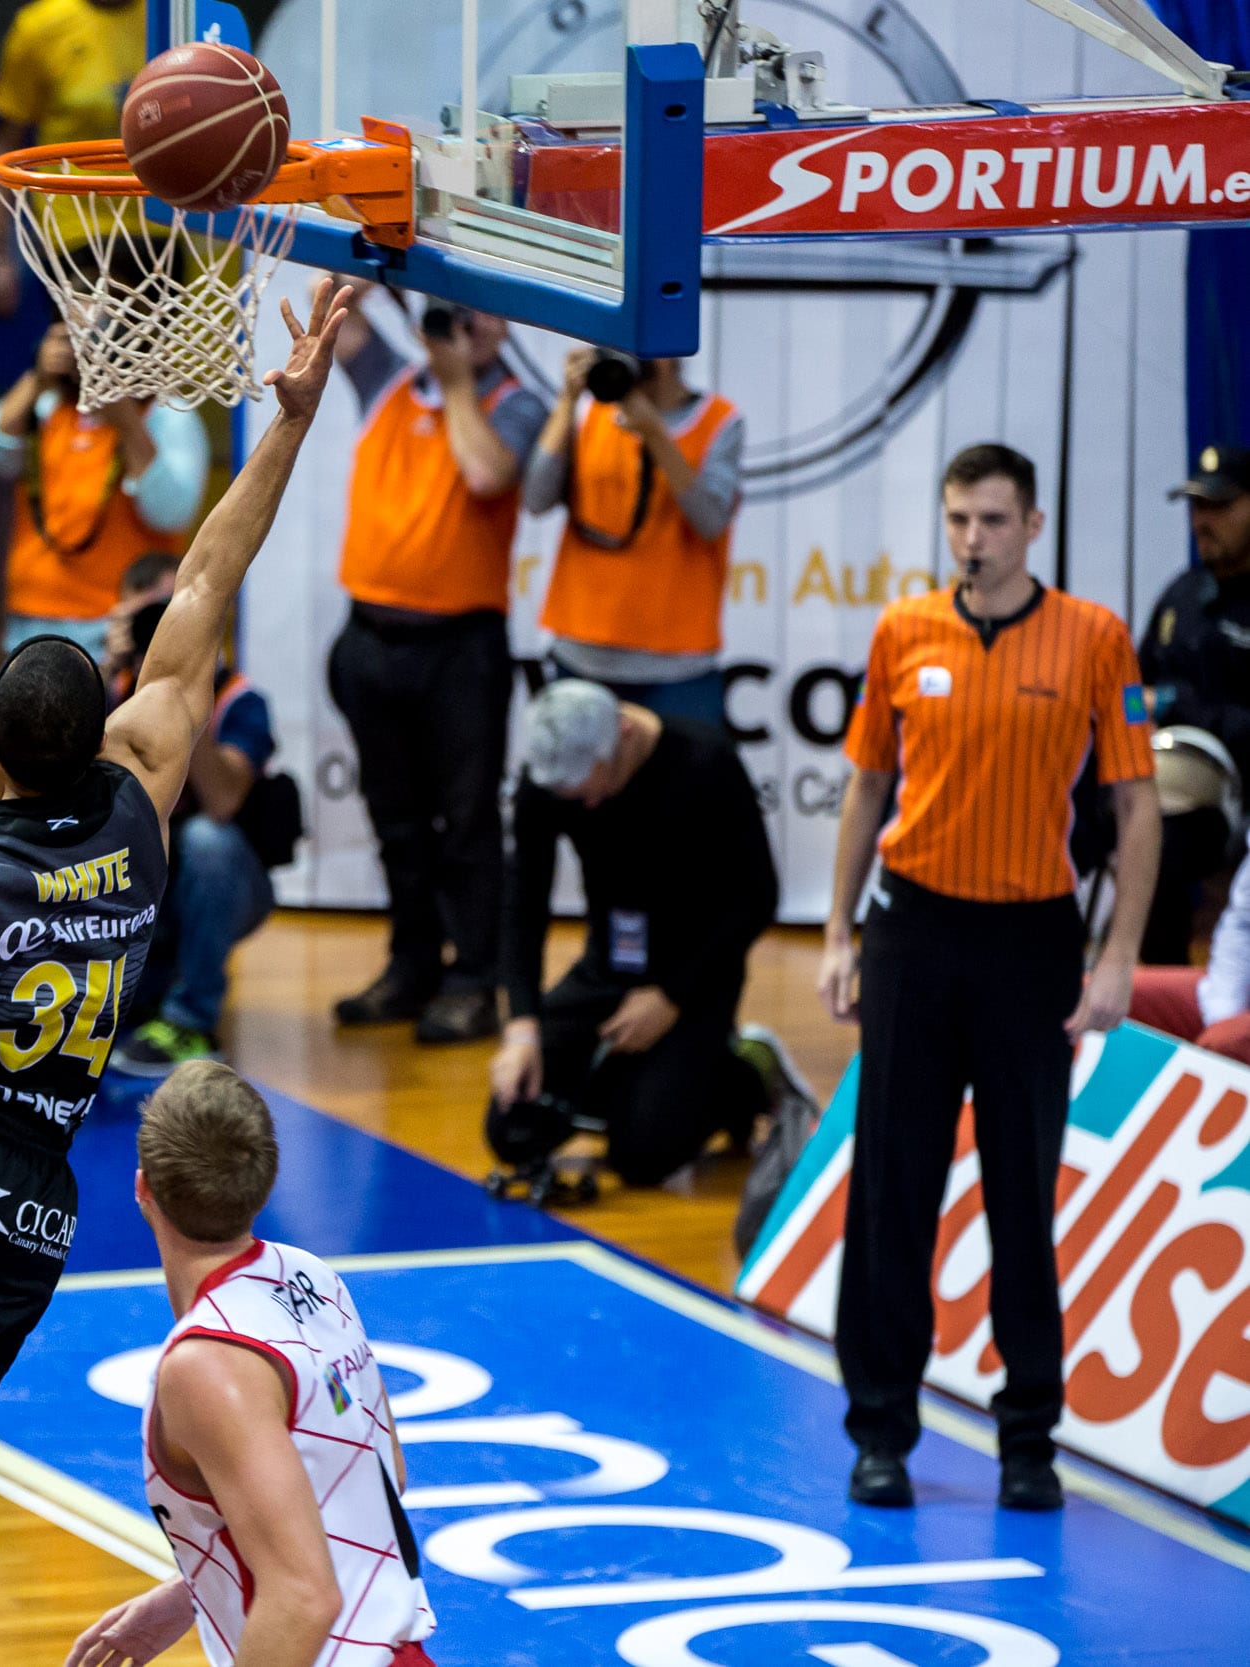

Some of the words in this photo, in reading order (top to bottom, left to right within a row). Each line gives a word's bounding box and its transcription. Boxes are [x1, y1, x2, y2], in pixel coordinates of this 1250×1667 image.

[31, 847, 132, 902] WHITE
[50, 903, 156, 944] AirEuropa
[8, 1231, 39, 1254] Canary
[38, 1241, 64, 1261] Islands
